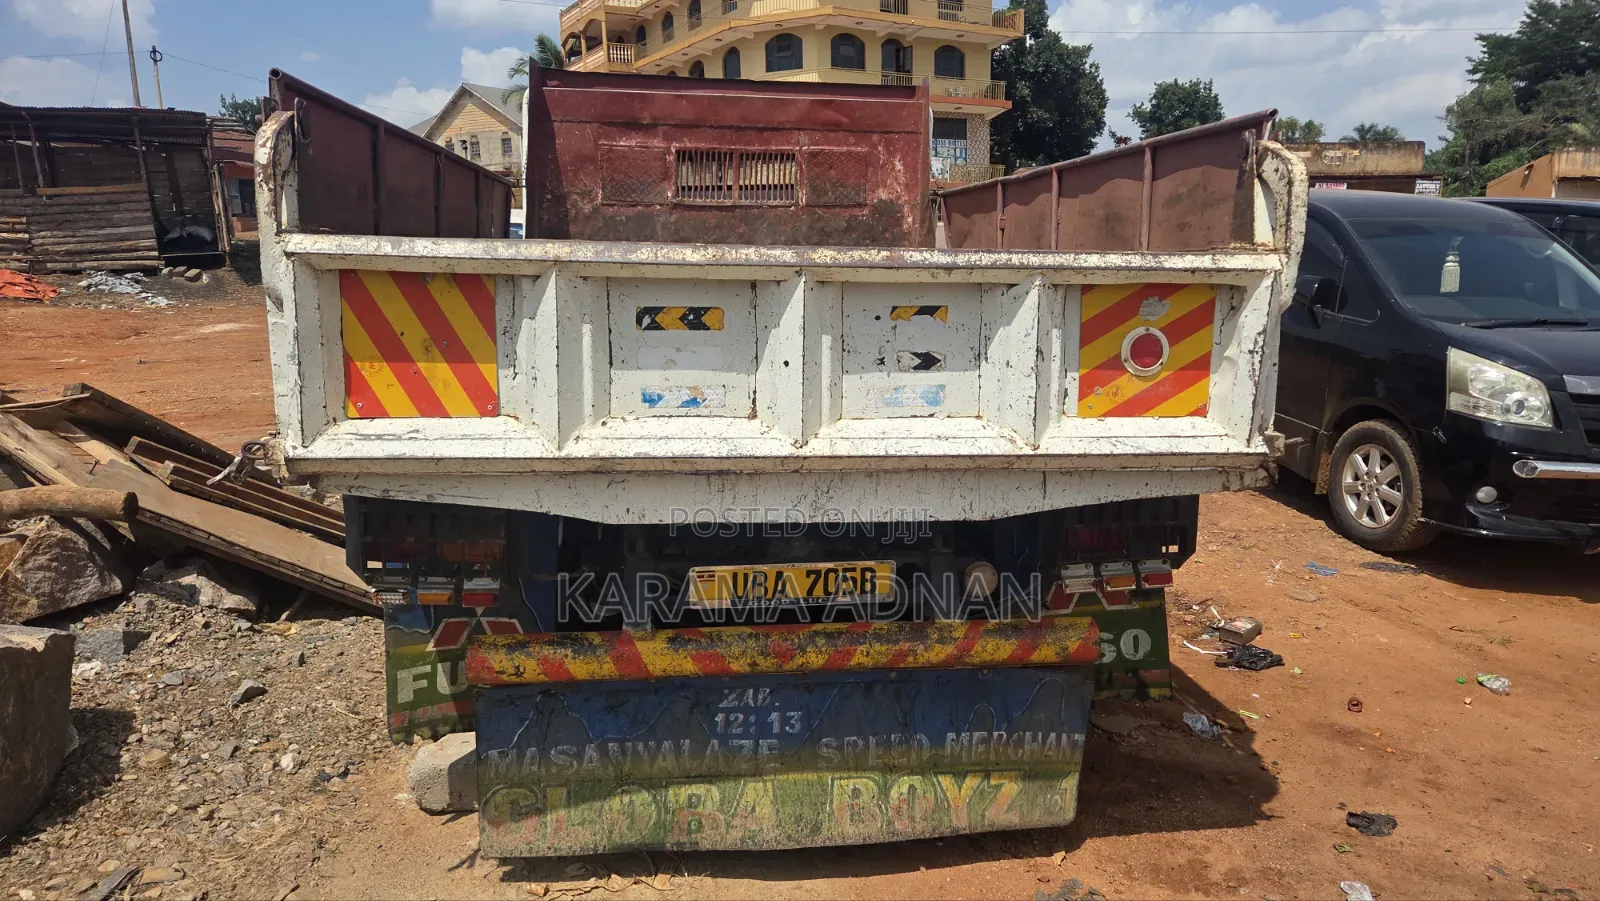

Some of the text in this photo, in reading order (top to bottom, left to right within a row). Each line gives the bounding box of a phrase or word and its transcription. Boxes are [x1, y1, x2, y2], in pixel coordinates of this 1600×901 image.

[732, 567, 877, 601] UBA 705B
[800, 597, 834, 605] LUC
[826, 768, 1028, 831] BOYZ
